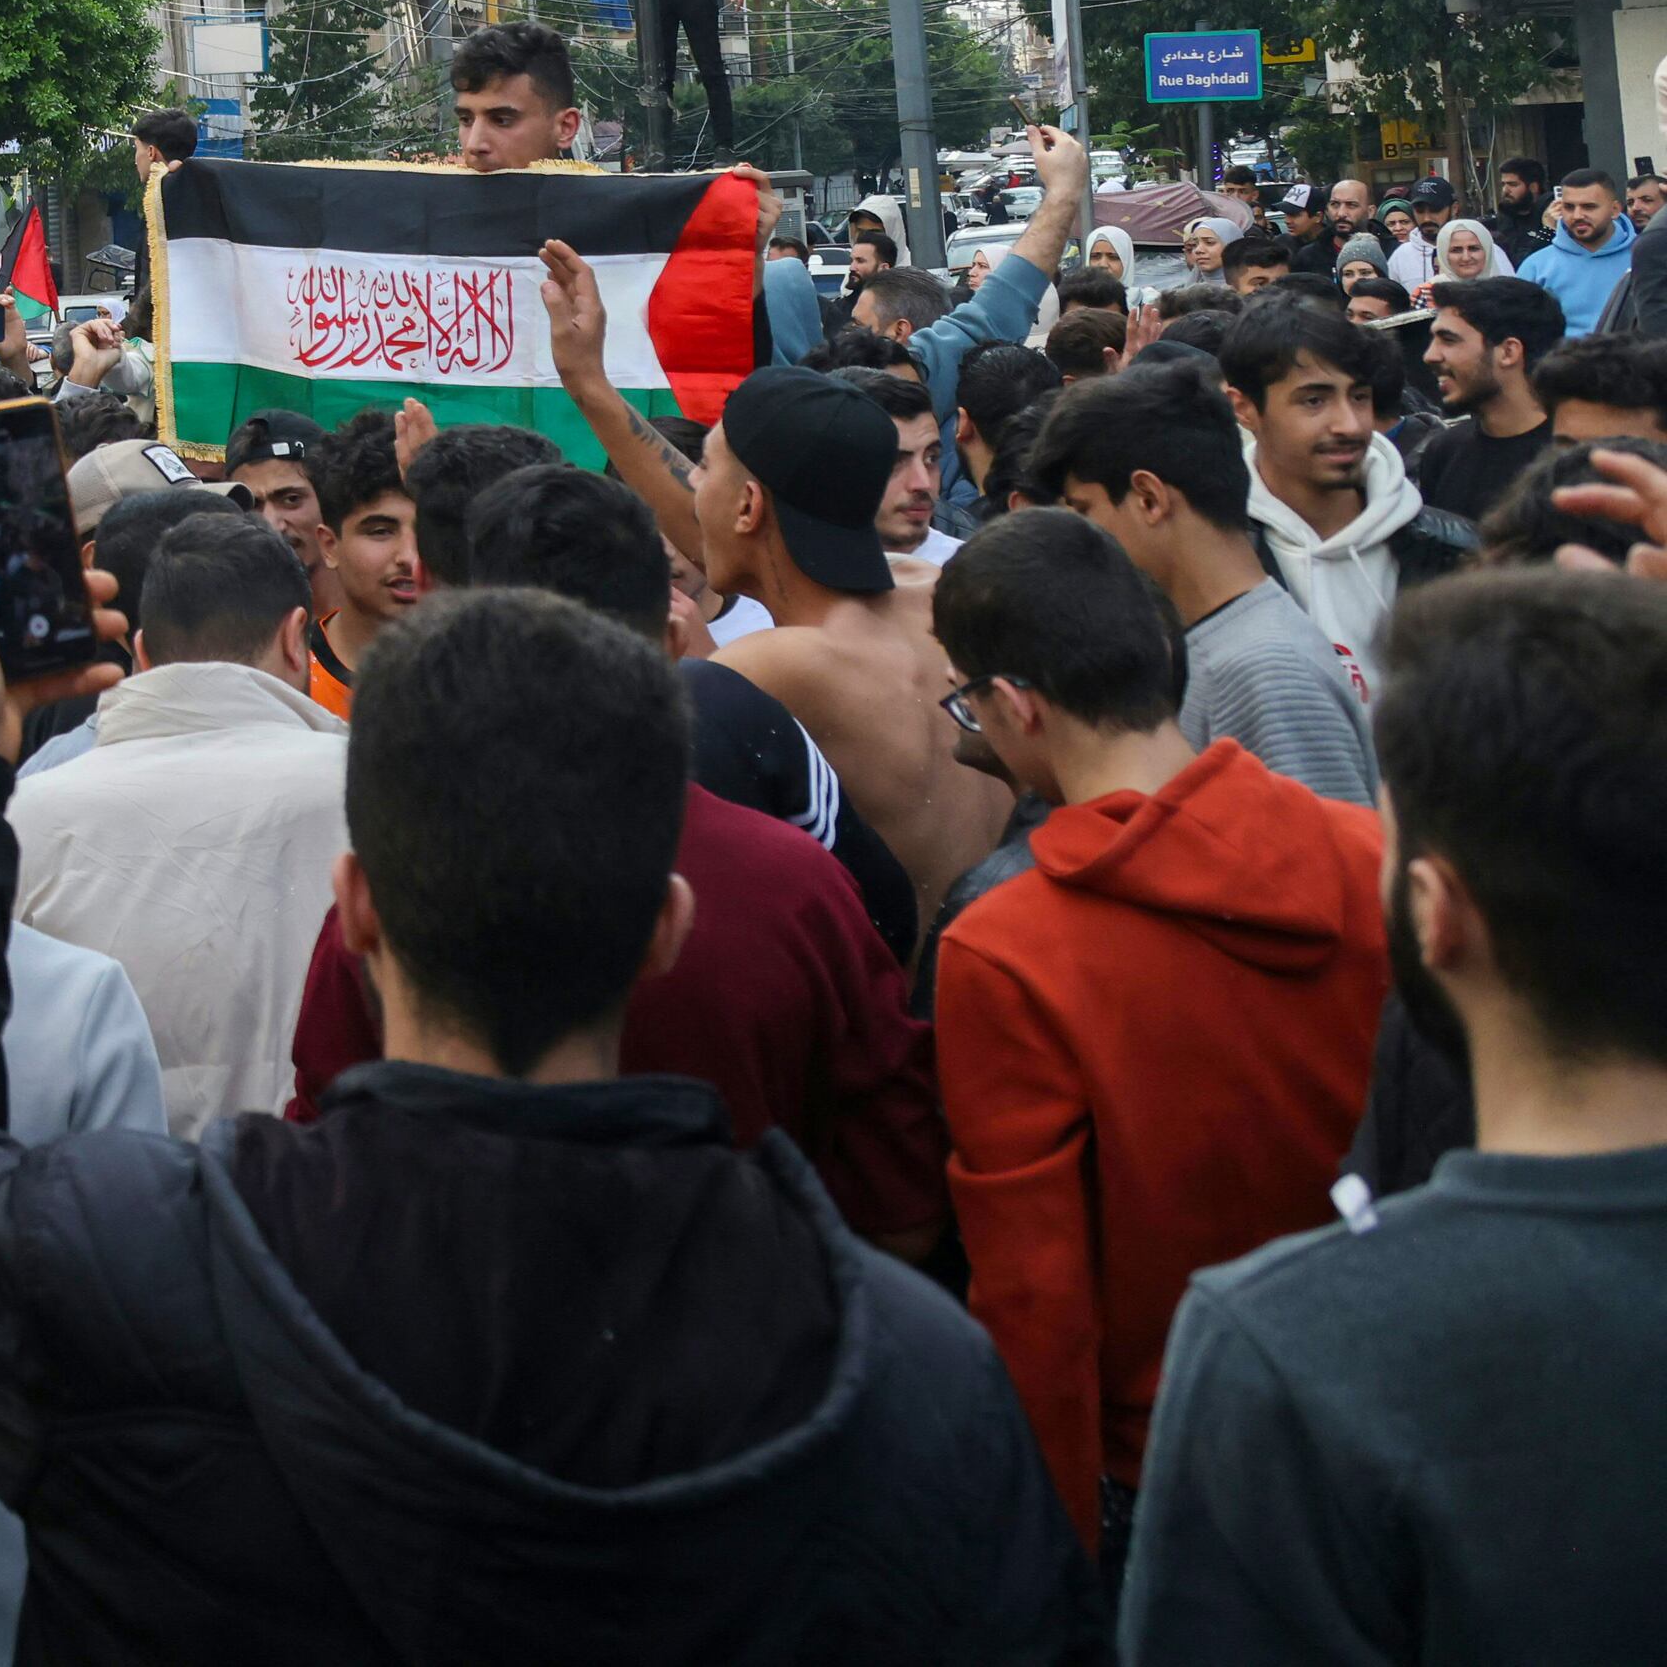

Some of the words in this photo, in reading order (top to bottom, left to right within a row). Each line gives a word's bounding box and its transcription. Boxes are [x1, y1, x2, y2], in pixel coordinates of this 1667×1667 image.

[1161, 49, 1204, 66] بغدادي
[1207, 46, 1243, 63] شارع
[1159, 75, 1183, 86] Rue
[1186, 72, 1249, 88] Baghdadi
[349, 307, 427, 371] محمد
